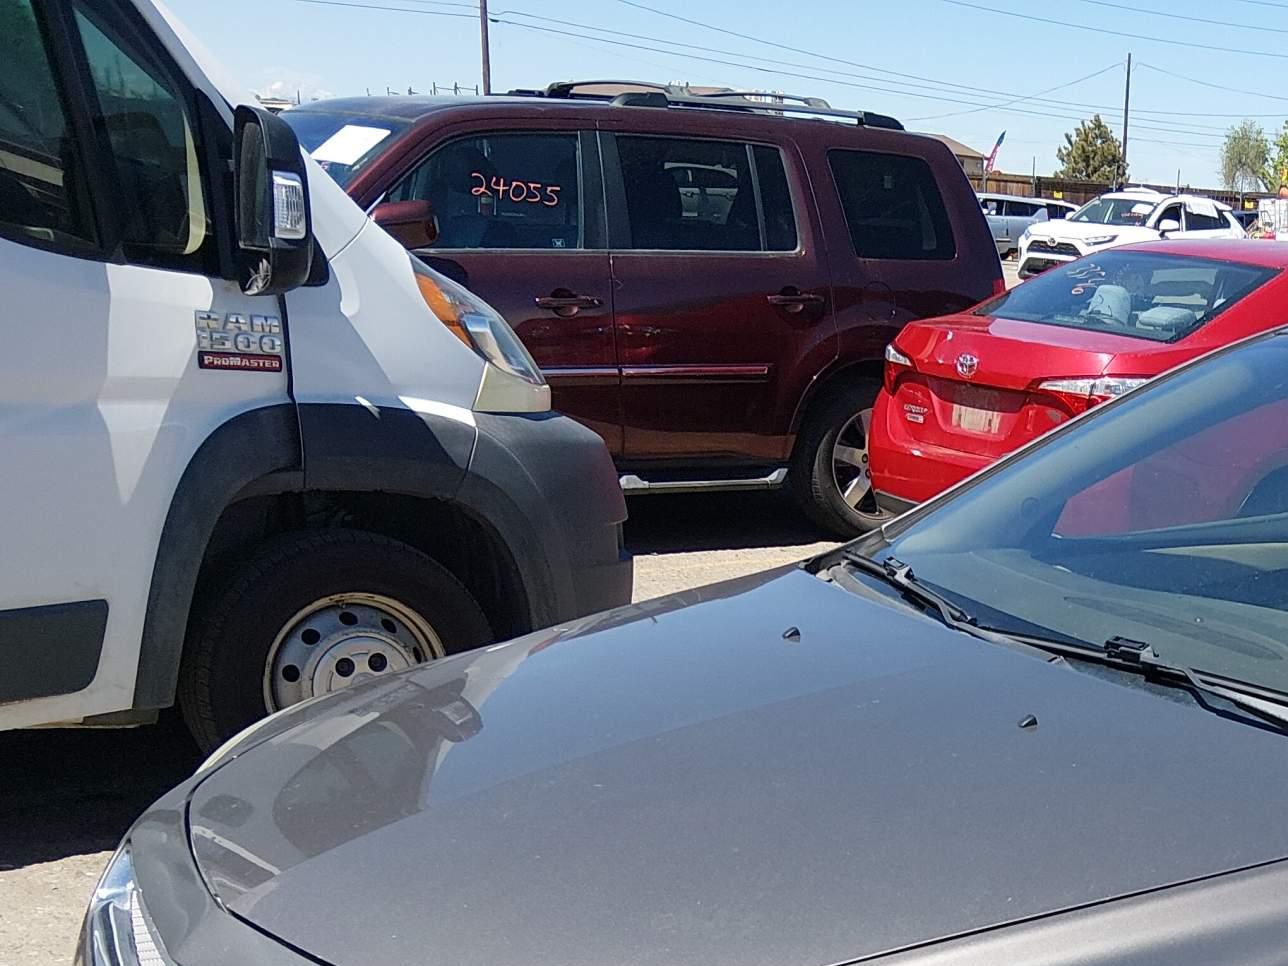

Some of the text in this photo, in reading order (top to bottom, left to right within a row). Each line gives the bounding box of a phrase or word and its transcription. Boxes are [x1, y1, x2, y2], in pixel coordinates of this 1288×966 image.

[470, 172, 561, 206] 24055
[195, 310, 280, 333] RAM
[196, 330, 282, 353] 1500
